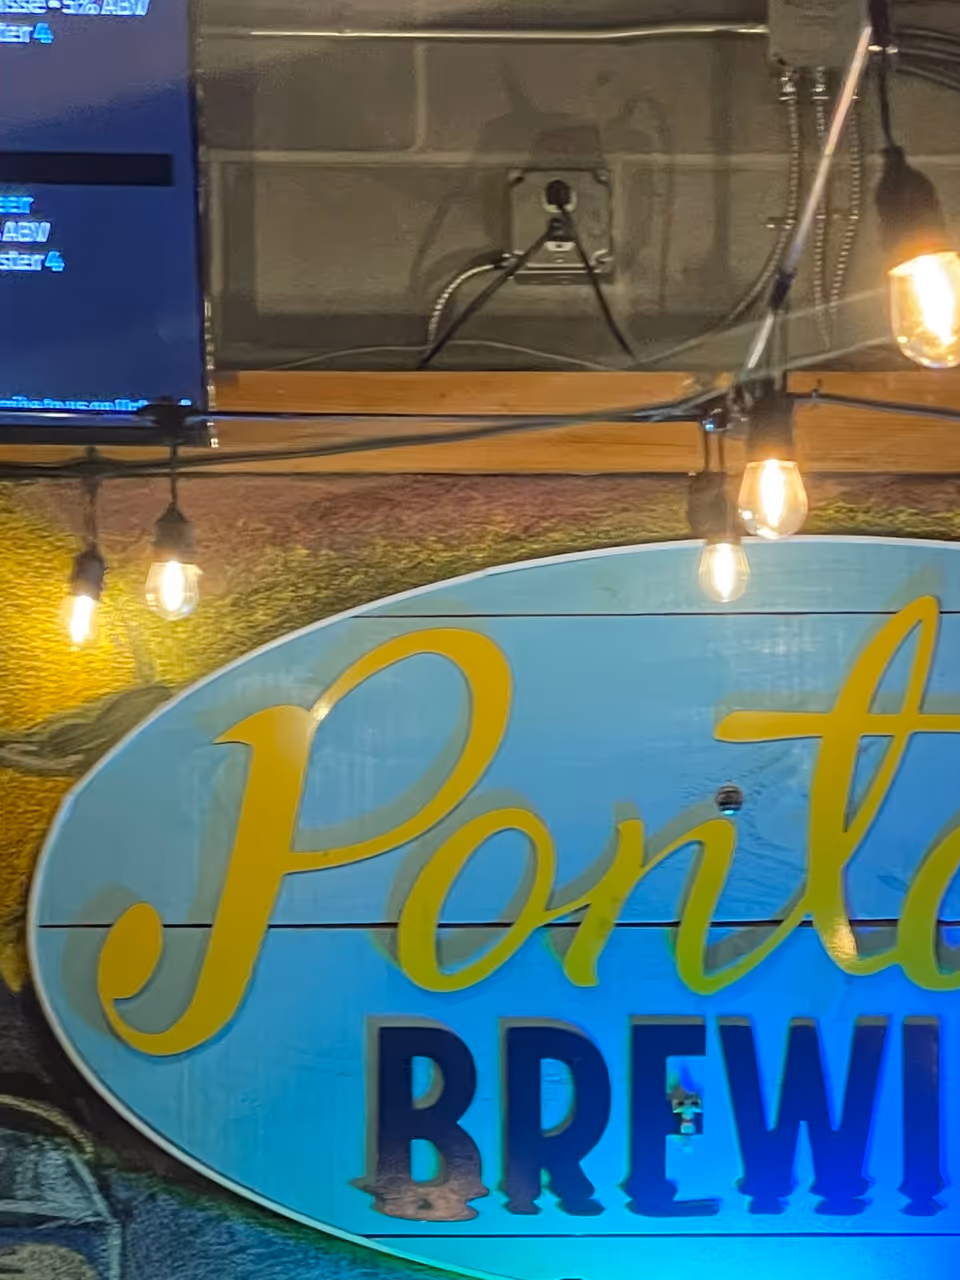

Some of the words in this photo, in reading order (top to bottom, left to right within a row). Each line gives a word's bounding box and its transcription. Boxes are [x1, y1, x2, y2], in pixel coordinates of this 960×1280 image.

[33, 22, 54, 44] 4
[2, 221, 51, 242] ABV
[44, 250, 65, 272] 4
